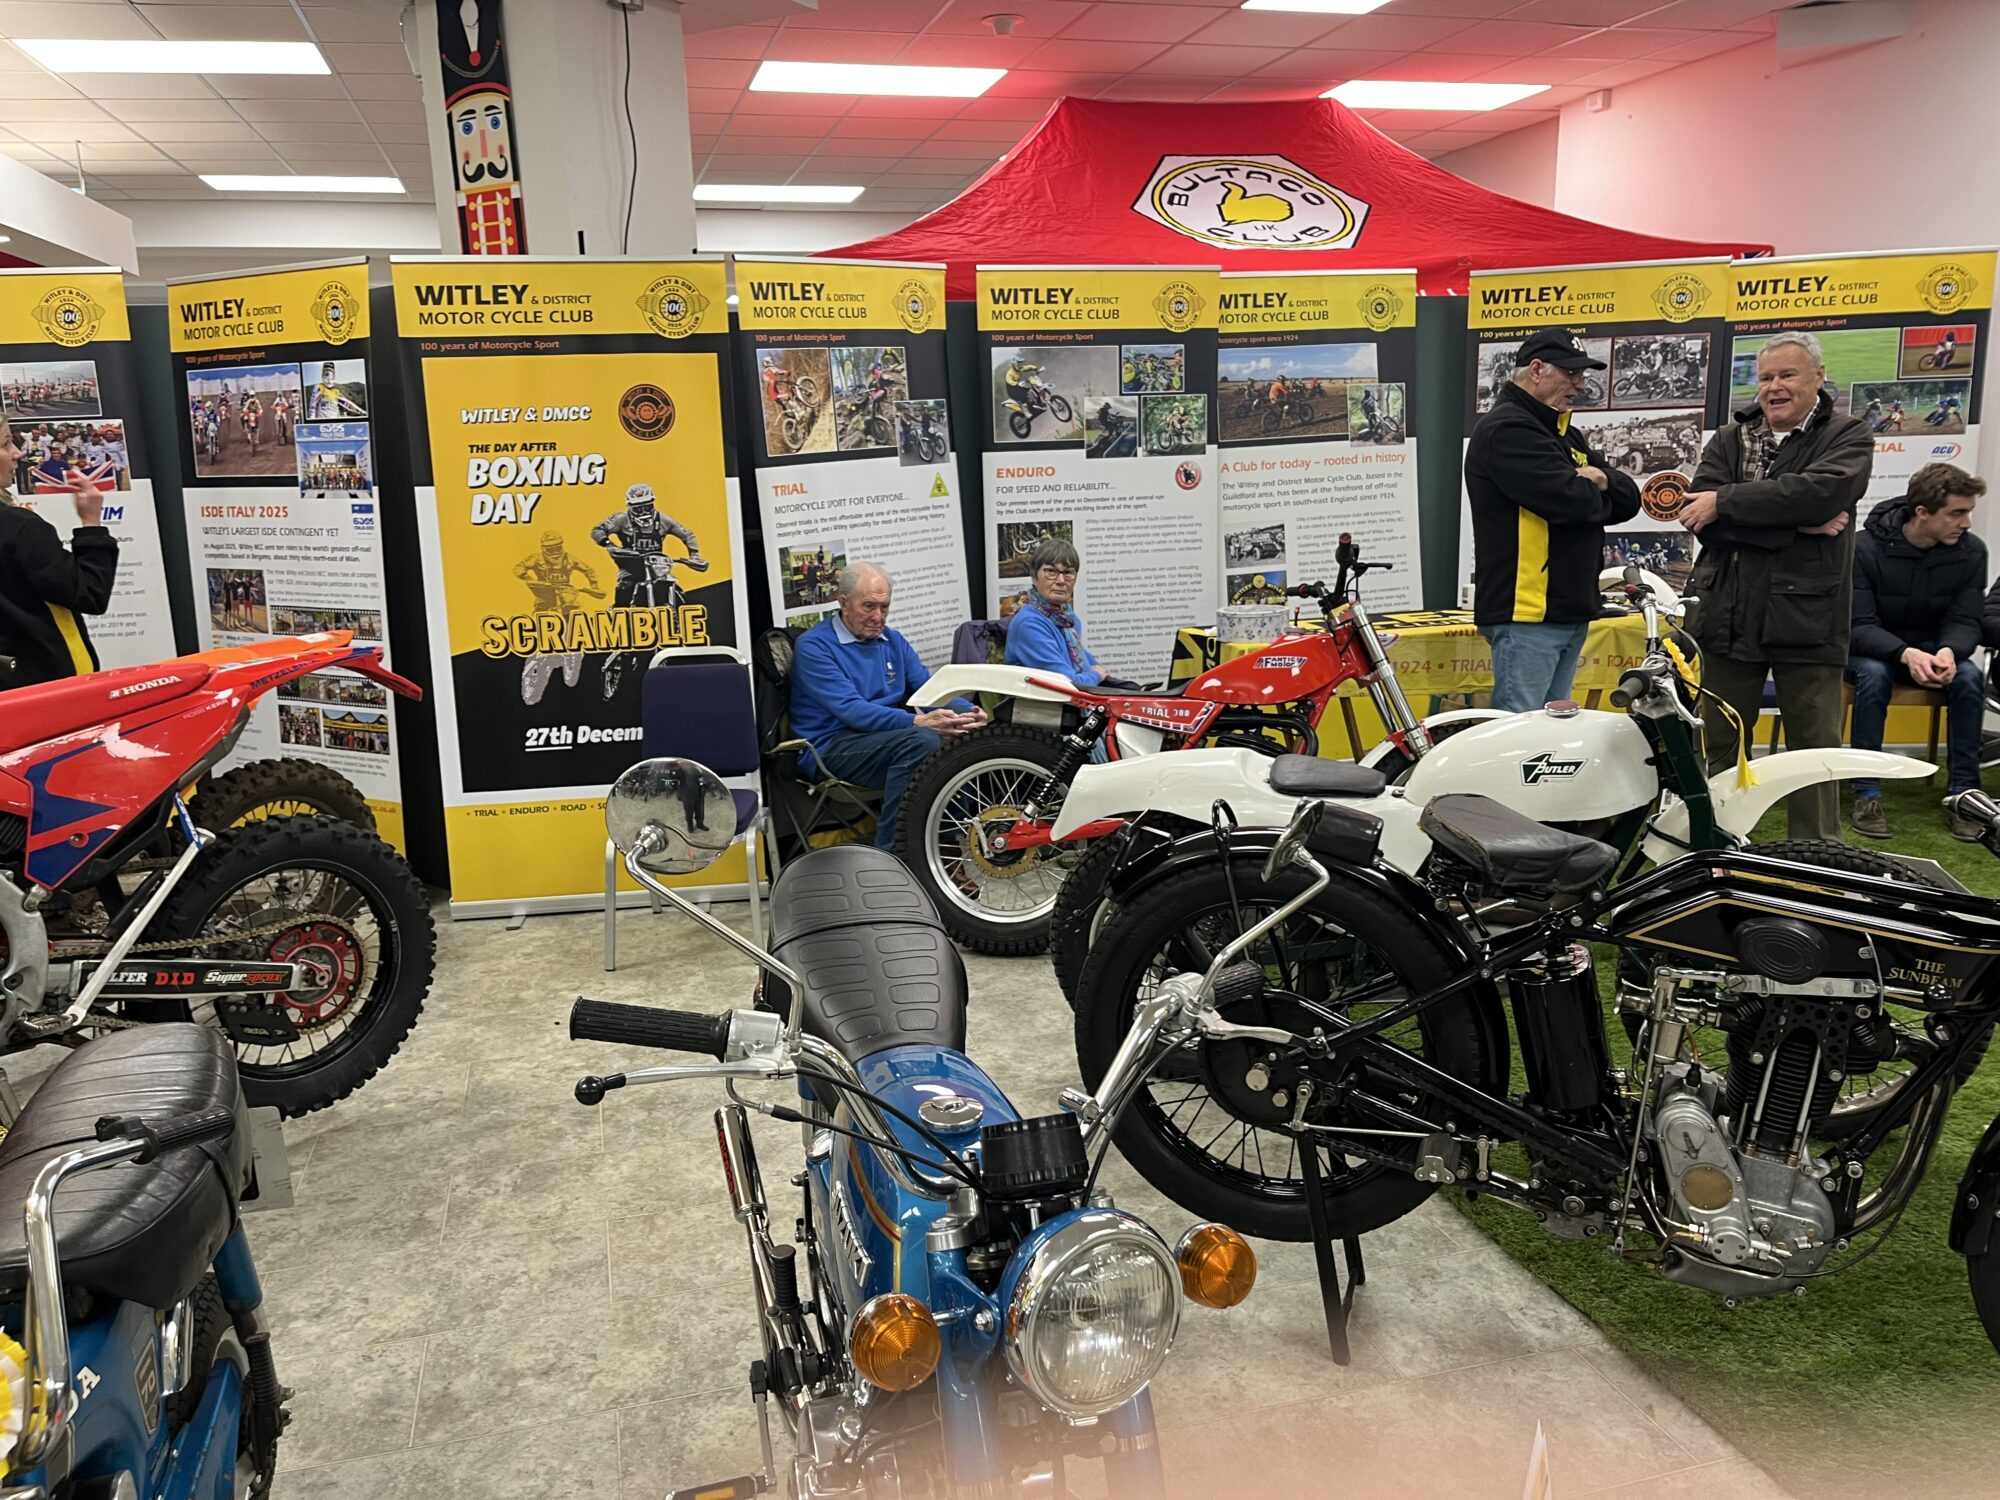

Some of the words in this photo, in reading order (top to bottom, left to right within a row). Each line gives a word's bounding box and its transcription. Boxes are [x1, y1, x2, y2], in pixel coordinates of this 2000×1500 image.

[1167, 167, 1325, 207] BULTACO
[1206, 225, 1330, 243] CLUB
[650, 280, 672, 294] WITLEY
[750, 282, 825, 301] WITLEY
[834, 294, 865, 302] DISTRICT
[1737, 276, 1829, 297] WITLEY
[1839, 282, 1880, 291] DISTRICT
[44, 290, 66, 304] WITLEY
[414, 284, 529, 306] WITLEY
[531, 296, 539, 304] &
[543, 295, 592, 304] DISTRICT
[990, 288, 1074, 305] WITLEY
[1074, 296, 1080, 304] &
[1083, 296, 1120, 304] DISTRICT
[1481, 285, 1568, 306] WITLEY
[1576, 291, 1616, 300] DISTRICT
[1736, 298, 1789, 312] MOTOR
[1794, 296, 1837, 308] CYCLE
[1842, 293, 1878, 306] CLUB
[181, 298, 245, 324] WITLEY
[246, 308, 251, 317] &
[252, 305, 282, 316] DISTRICT
[753, 306, 796, 318] MOTOR
[800, 307, 834, 318] CYCLE
[838, 307, 868, 318] CLUB
[1296, 300, 1328, 308] DISTRICT
[1481, 308, 1530, 320] MOTOR
[1535, 305, 1576, 316] CYCLE
[1580, 303, 1615, 314] CLUB
[419, 312, 484, 325] MOTOR
[491, 311, 543, 324] CYCLE
[550, 310, 593, 323] CLUB
[992, 310, 1040, 320] MOTOR
[1044, 309, 1083, 320] CYCLE
[1087, 308, 1120, 320] CLUB
[1262, 312, 1296, 323] CYCLE
[1300, 310, 1329, 321] CLUB
[184, 326, 220, 340] MOTOR
[222, 322, 254, 337] CYCLE
[258, 320, 284, 334] CLUB
[649, 316, 667, 334] MOTOR
[688, 316, 700, 330] CLUB
[1750, 324, 1770, 332] years
[1782, 319, 1824, 330] Motorcycle
[1826, 318, 1848, 326] Sport
[756, 334, 768, 342] 100
[769, 334, 786, 343] years
[794, 334, 828, 343] Motorcycle
[830, 334, 846, 342] Sport
[1006, 334, 1025, 342] years
[1035, 333, 1074, 342] Motorcycle
[1075, 333, 1094, 341] Sport
[1494, 332, 1514, 340] years
[421, 342, 438, 350] 100
[440, 343, 466, 352] years
[468, 342, 479, 350] of
[481, 340, 532, 350] Motorcycle
[534, 340, 560, 350] Sport
[461, 407, 521, 424] WITLEY
[524, 406, 538, 422] &
[542, 405, 592, 422] DMCC
[468, 444, 492, 454] THE
[494, 443, 518, 452] DAY
[520, 442, 557, 452] AFTER
[1220, 463, 1230, 473] A
[1233, 461, 1258, 472] Club
[1261, 460, 1276, 470] for
[1280, 458, 1311, 471] today
[1324, 454, 1358, 466] rooted
[1362, 454, 1373, 464] in
[1376, 452, 1406, 464] history
[466, 453, 607, 489] BOXING
[996, 466, 1056, 479] ENDURO
[1016, 486, 1040, 494] SPEED
[1042, 484, 1061, 492] AND
[1238, 481, 1260, 490] Witley
[1262, 479, 1276, 487] and
[1278, 478, 1302, 486] District
[1304, 476, 1325, 484] Motor
[1328, 475, 1344, 484] Cycle
[1346, 474, 1364, 482] Club,
[1366, 472, 1385, 480] based
[772, 482, 808, 497] TRIAL
[201, 506, 224, 518] ISDE
[227, 506, 256, 518] ITALY
[259, 506, 288, 518] 2025
[470, 492, 542, 525] DAY
[774, 502, 826, 515] MOTORCYCLE
[827, 498, 847, 509] SPORT
[848, 497, 864, 506] FOR
[231, 527, 260, 536] LARGEST
[262, 528, 278, 536] ISDE
[280, 528, 324, 536] CONTINGENT
[325, 528, 339, 536] YET
[480, 605, 710, 658] SCRAMBLE
[1264, 658, 1296, 667] FANTIC
[1393, 661, 1432, 675] 1924
[1450, 659, 1492, 674] TRIAL
[122, 676, 182, 695] HONDA
[1141, 706, 1170, 718] TRIAL
[525, 725, 574, 747] 27th
[577, 725, 644, 744] Decem
[474, 808, 498, 817] TRIAL
[509, 805, 550, 816] ENDURO
[560, 803, 587, 812] ROAD
[1915, 958, 1946, 974] THE
[155, 972, 196, 986] DID
[1889, 967, 1963, 988] SUNBEAM
